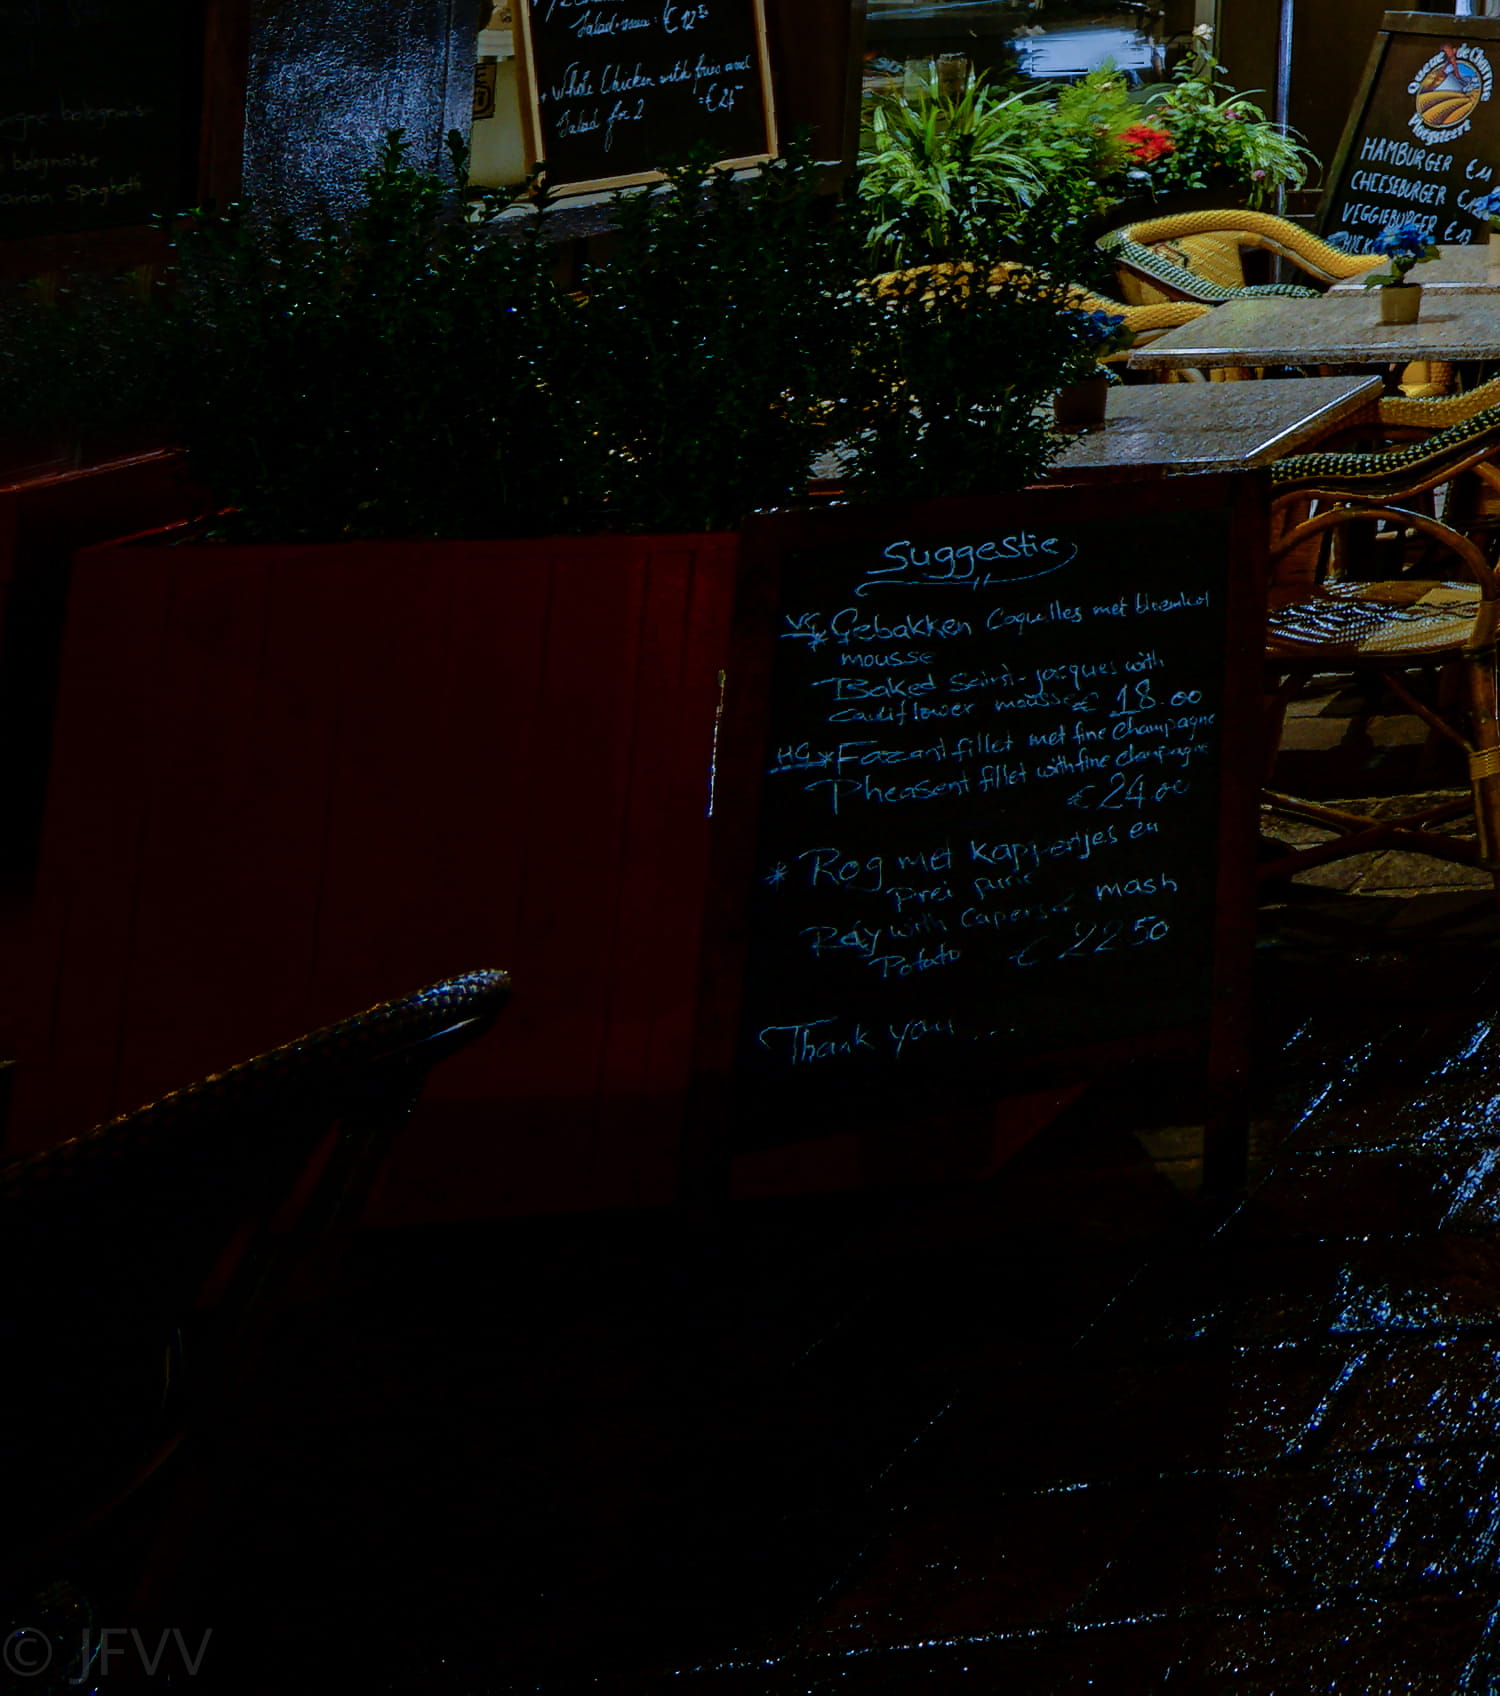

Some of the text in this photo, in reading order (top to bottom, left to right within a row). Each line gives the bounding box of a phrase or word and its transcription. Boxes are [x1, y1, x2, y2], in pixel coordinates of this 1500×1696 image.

[600, 62, 656, 95] Chicken
[659, 58, 692, 84] with
[1359, 136, 1455, 172] HAMBURGER
[1350, 168, 1448, 207] CHEESEBURGER
[1341, 201, 1439, 238] VEGGIEBURGER
[866, 530, 1061, 580] Suggestie
[830, 608, 973, 646] Gebakken
[1092, 595, 1128, 617] met
[811, 673, 937, 701] Baked
[1125, 649, 1165, 673] with
[841, 652, 933, 668] mousse
[1028, 723, 1067, 747] met
[1074, 719, 1109, 747] fine
[979, 761, 1028, 793] fillet
[1036, 753, 1076, 780] with
[1075, 746, 1112, 772] fine
[799, 847, 885, 893] Rog
[896, 836, 953, 874] met
[1095, 871, 1179, 902] mash
[867, 942, 962, 981] Potato
[758, 1015, 878, 1066] Thank
